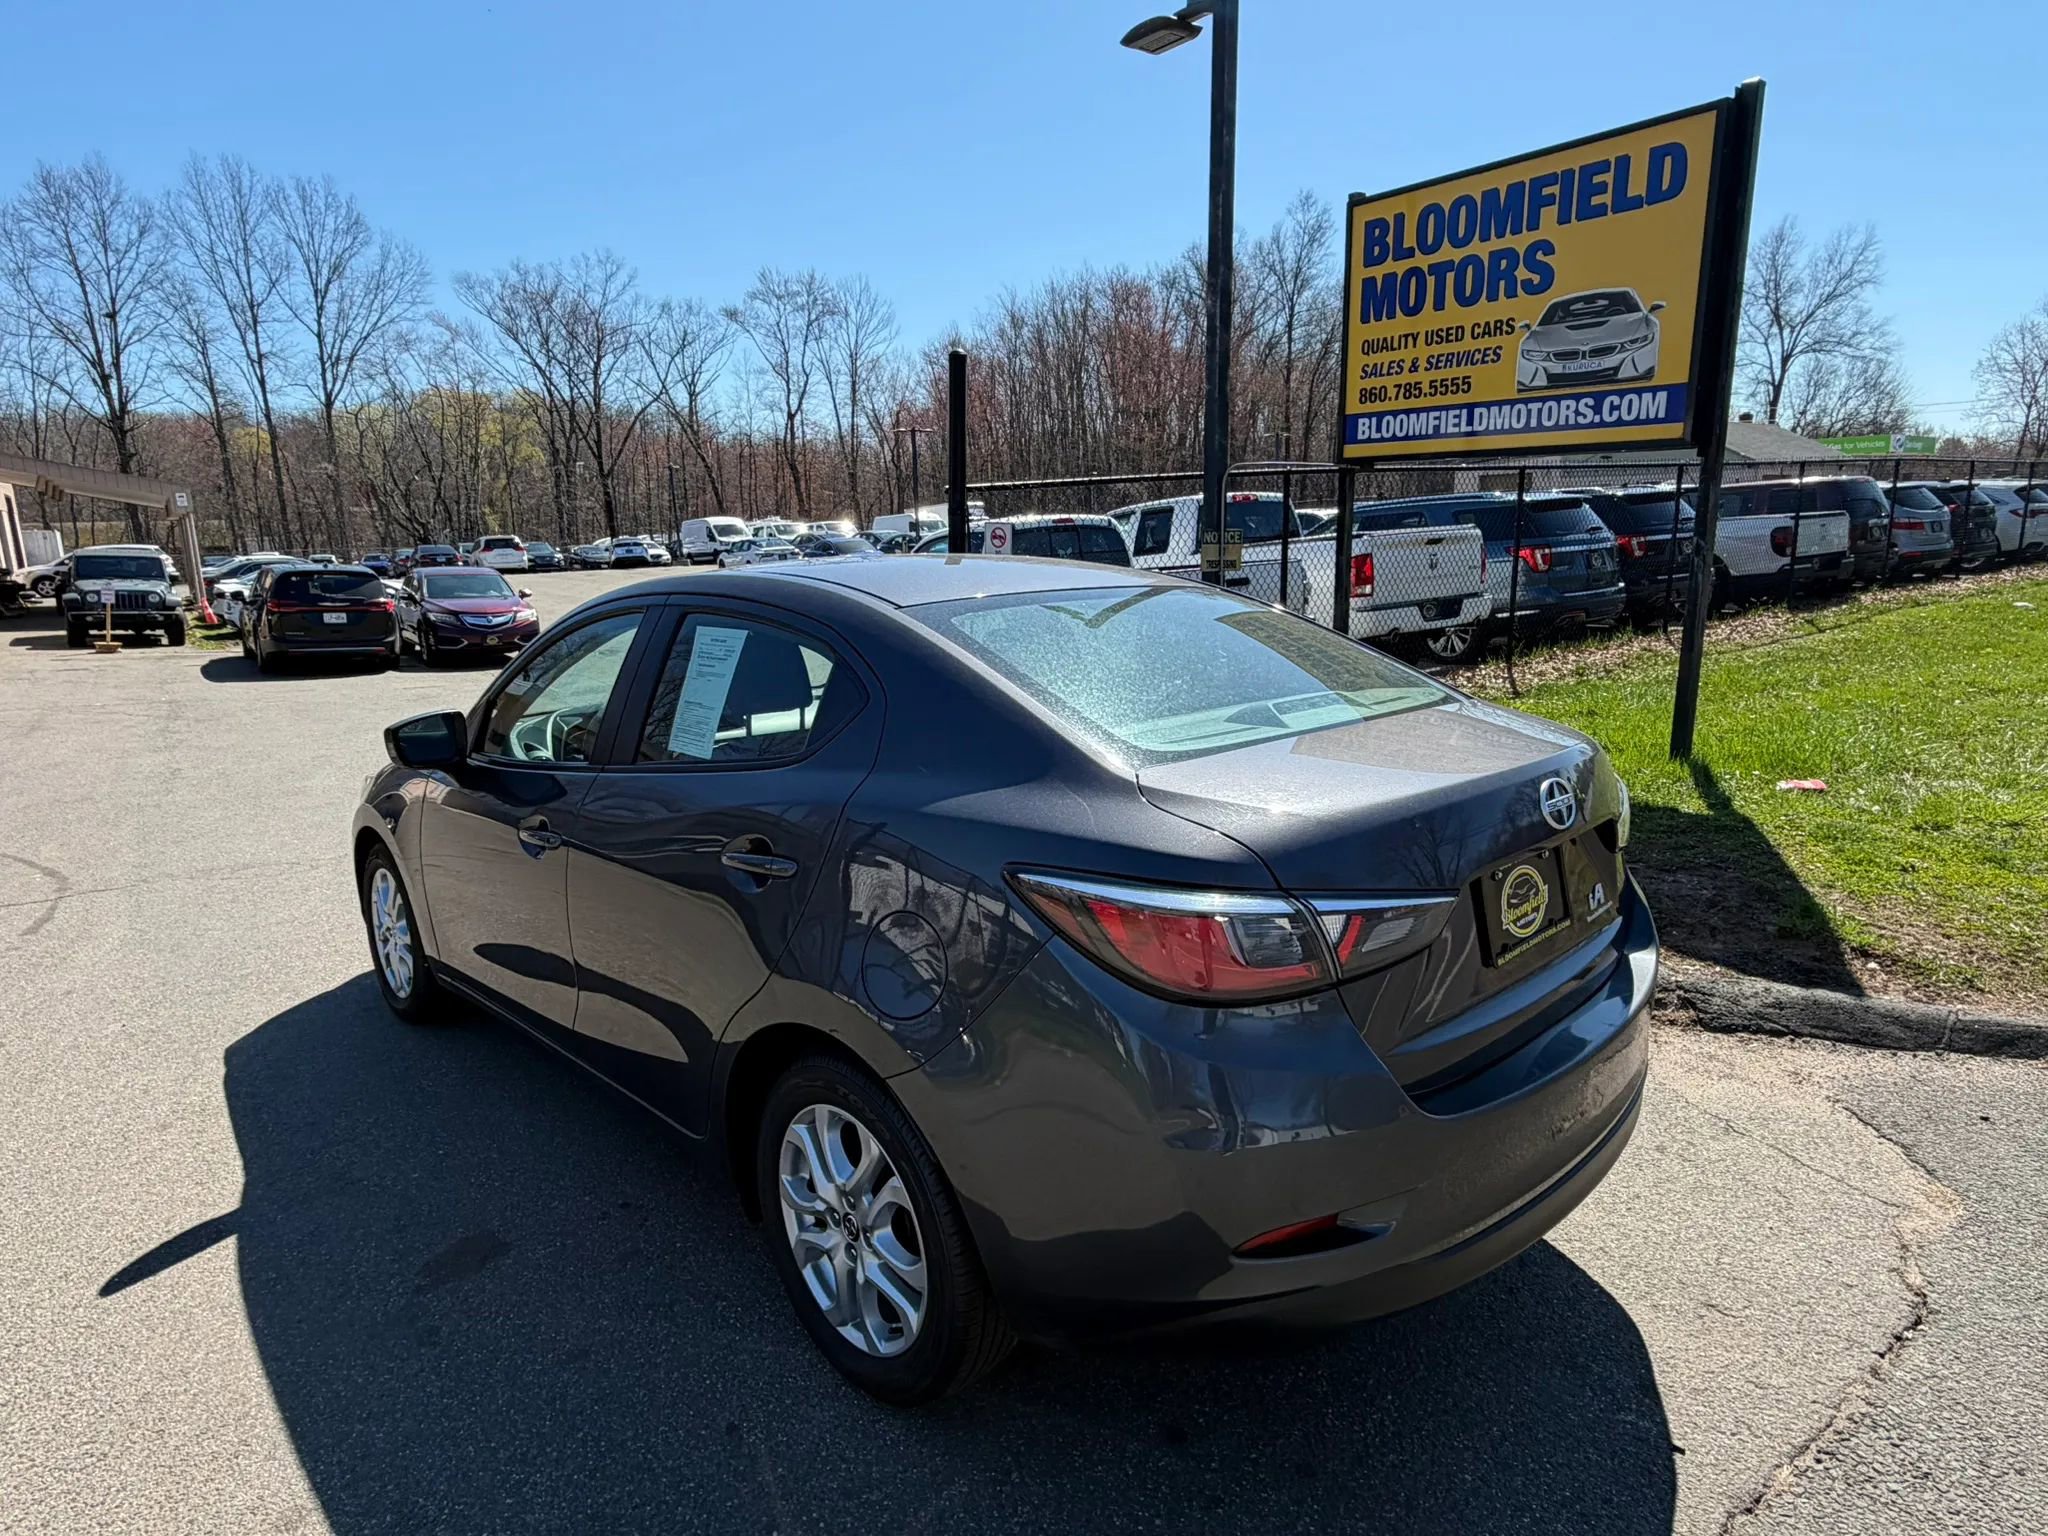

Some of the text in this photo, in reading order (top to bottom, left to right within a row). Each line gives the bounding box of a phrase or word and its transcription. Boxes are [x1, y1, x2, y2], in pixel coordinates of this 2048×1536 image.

[1363, 142, 1688, 268] BLOOMFIELD
[1360, 239, 1556, 325] MOTORS
[1361, 317, 1516, 356] QUALITY USED CARS
[1360, 345, 1503, 380] SALES & SERVICES
[1359, 375, 1472, 405] 860.785.5555
[1357, 391, 1668, 440] BLOOMFIELDMOTORS.COM
[1203, 531, 1241, 543] NOICE
[1504, 888, 1548, 924] Bloomfield
